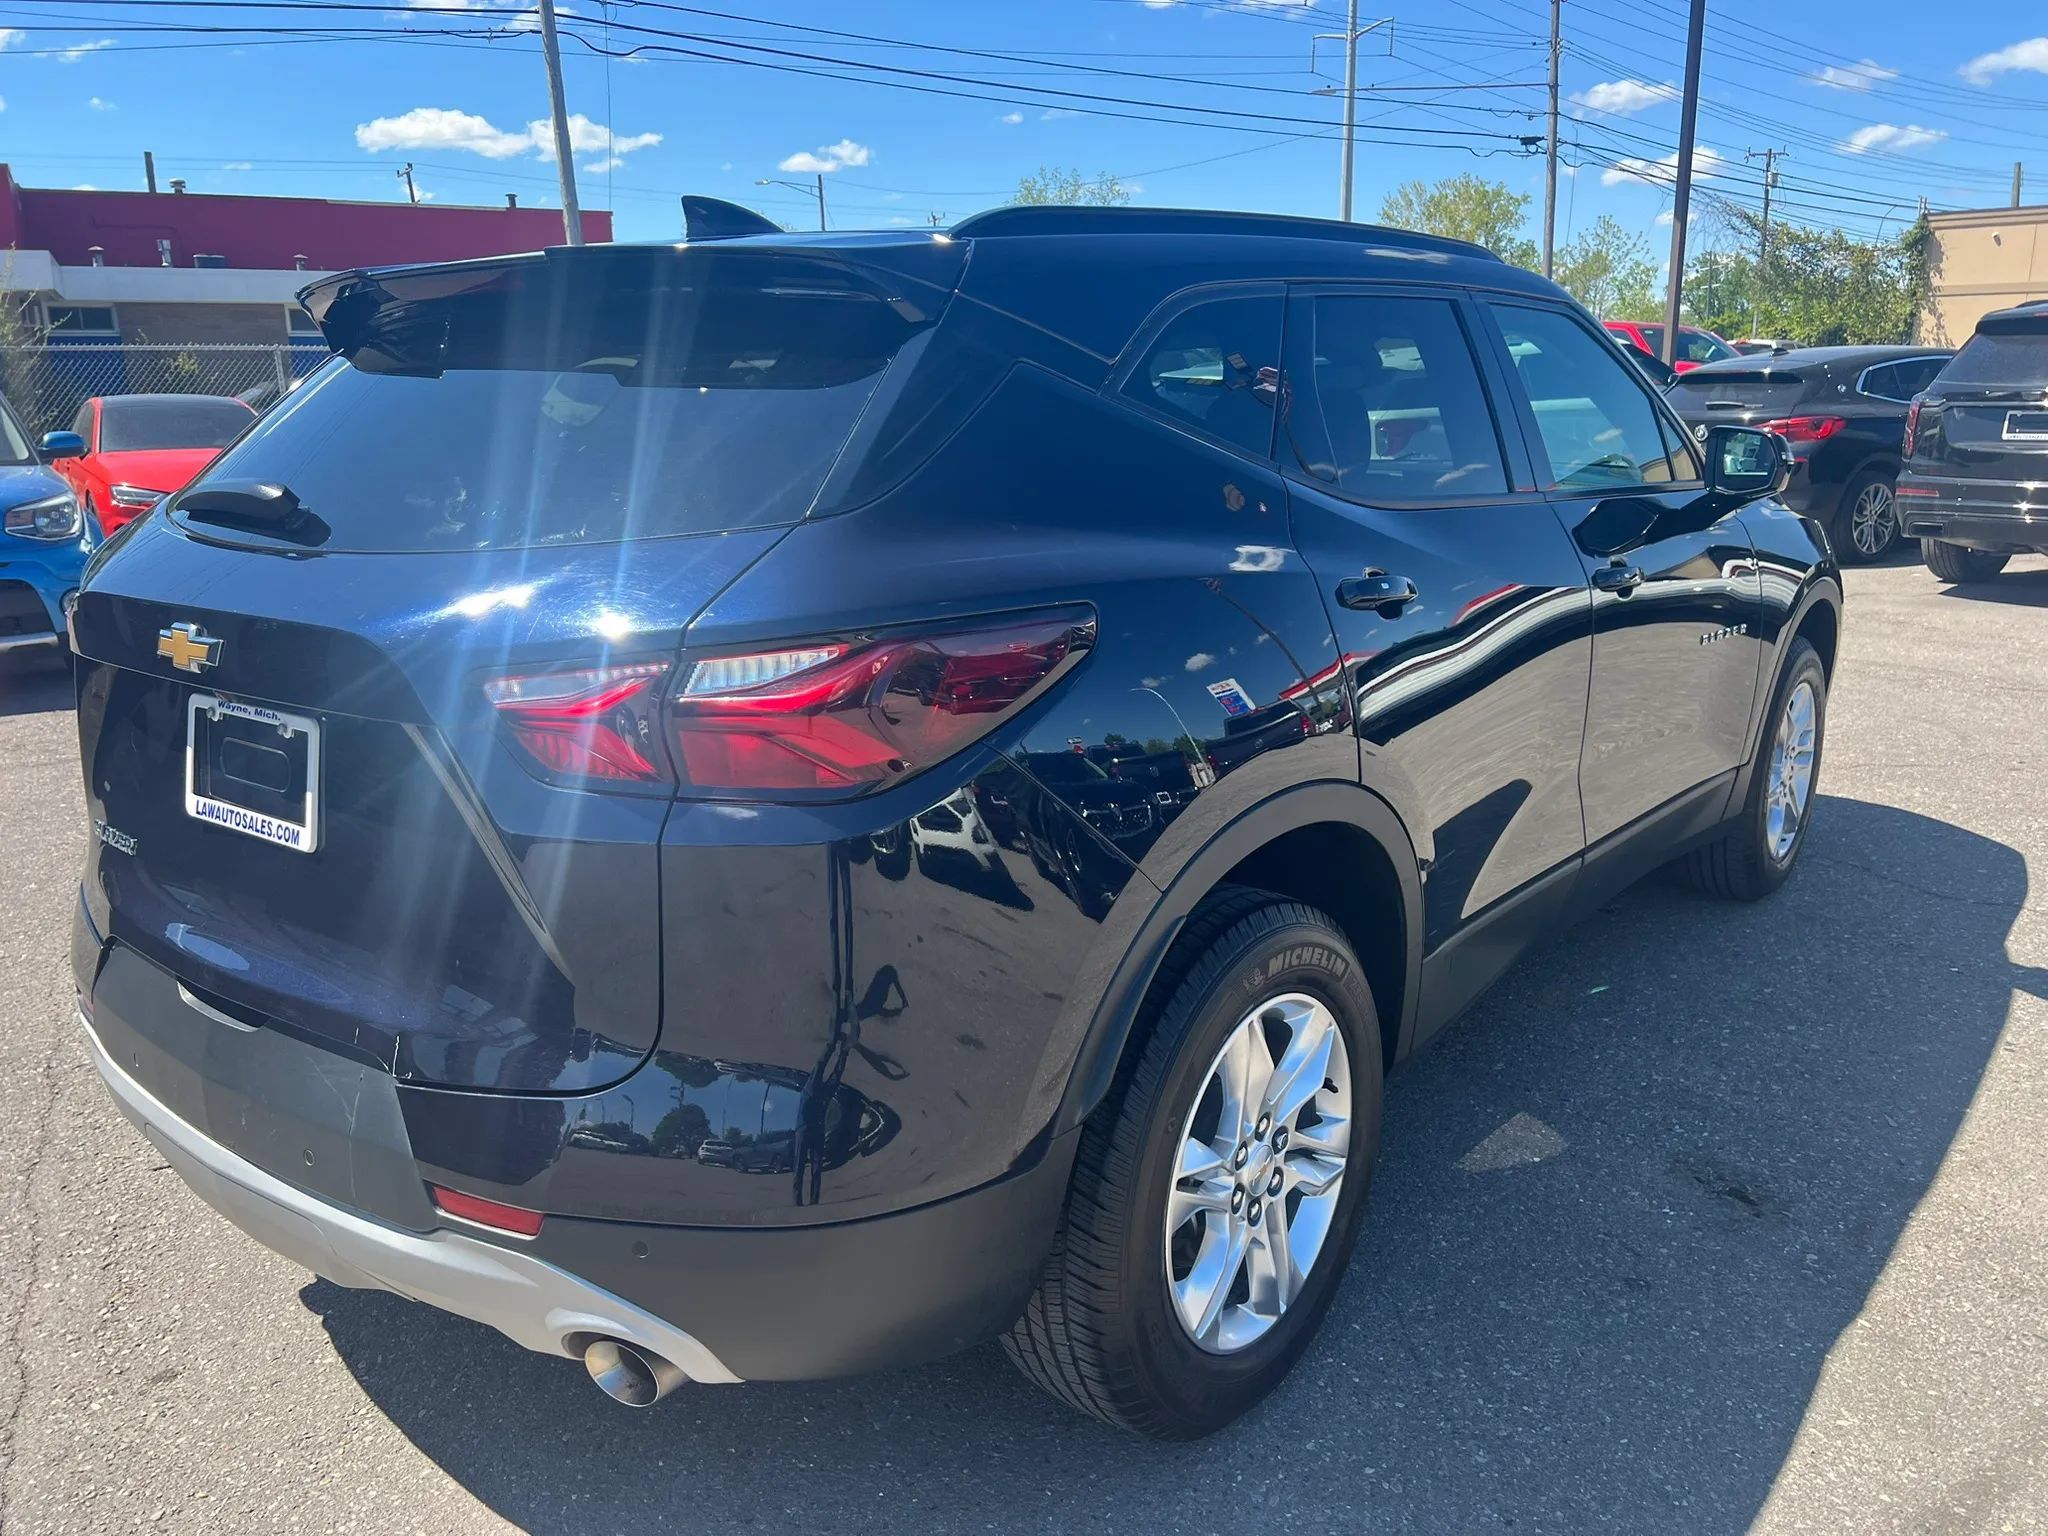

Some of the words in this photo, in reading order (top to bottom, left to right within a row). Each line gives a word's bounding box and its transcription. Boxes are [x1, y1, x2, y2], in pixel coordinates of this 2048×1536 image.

[217, 700, 252, 715] Wayne,
[254, 708, 281, 721] Mich.
[196, 799, 301, 846] LAWAUTOSALES.COM
[1267, 947, 1346, 979] MICHELIN
